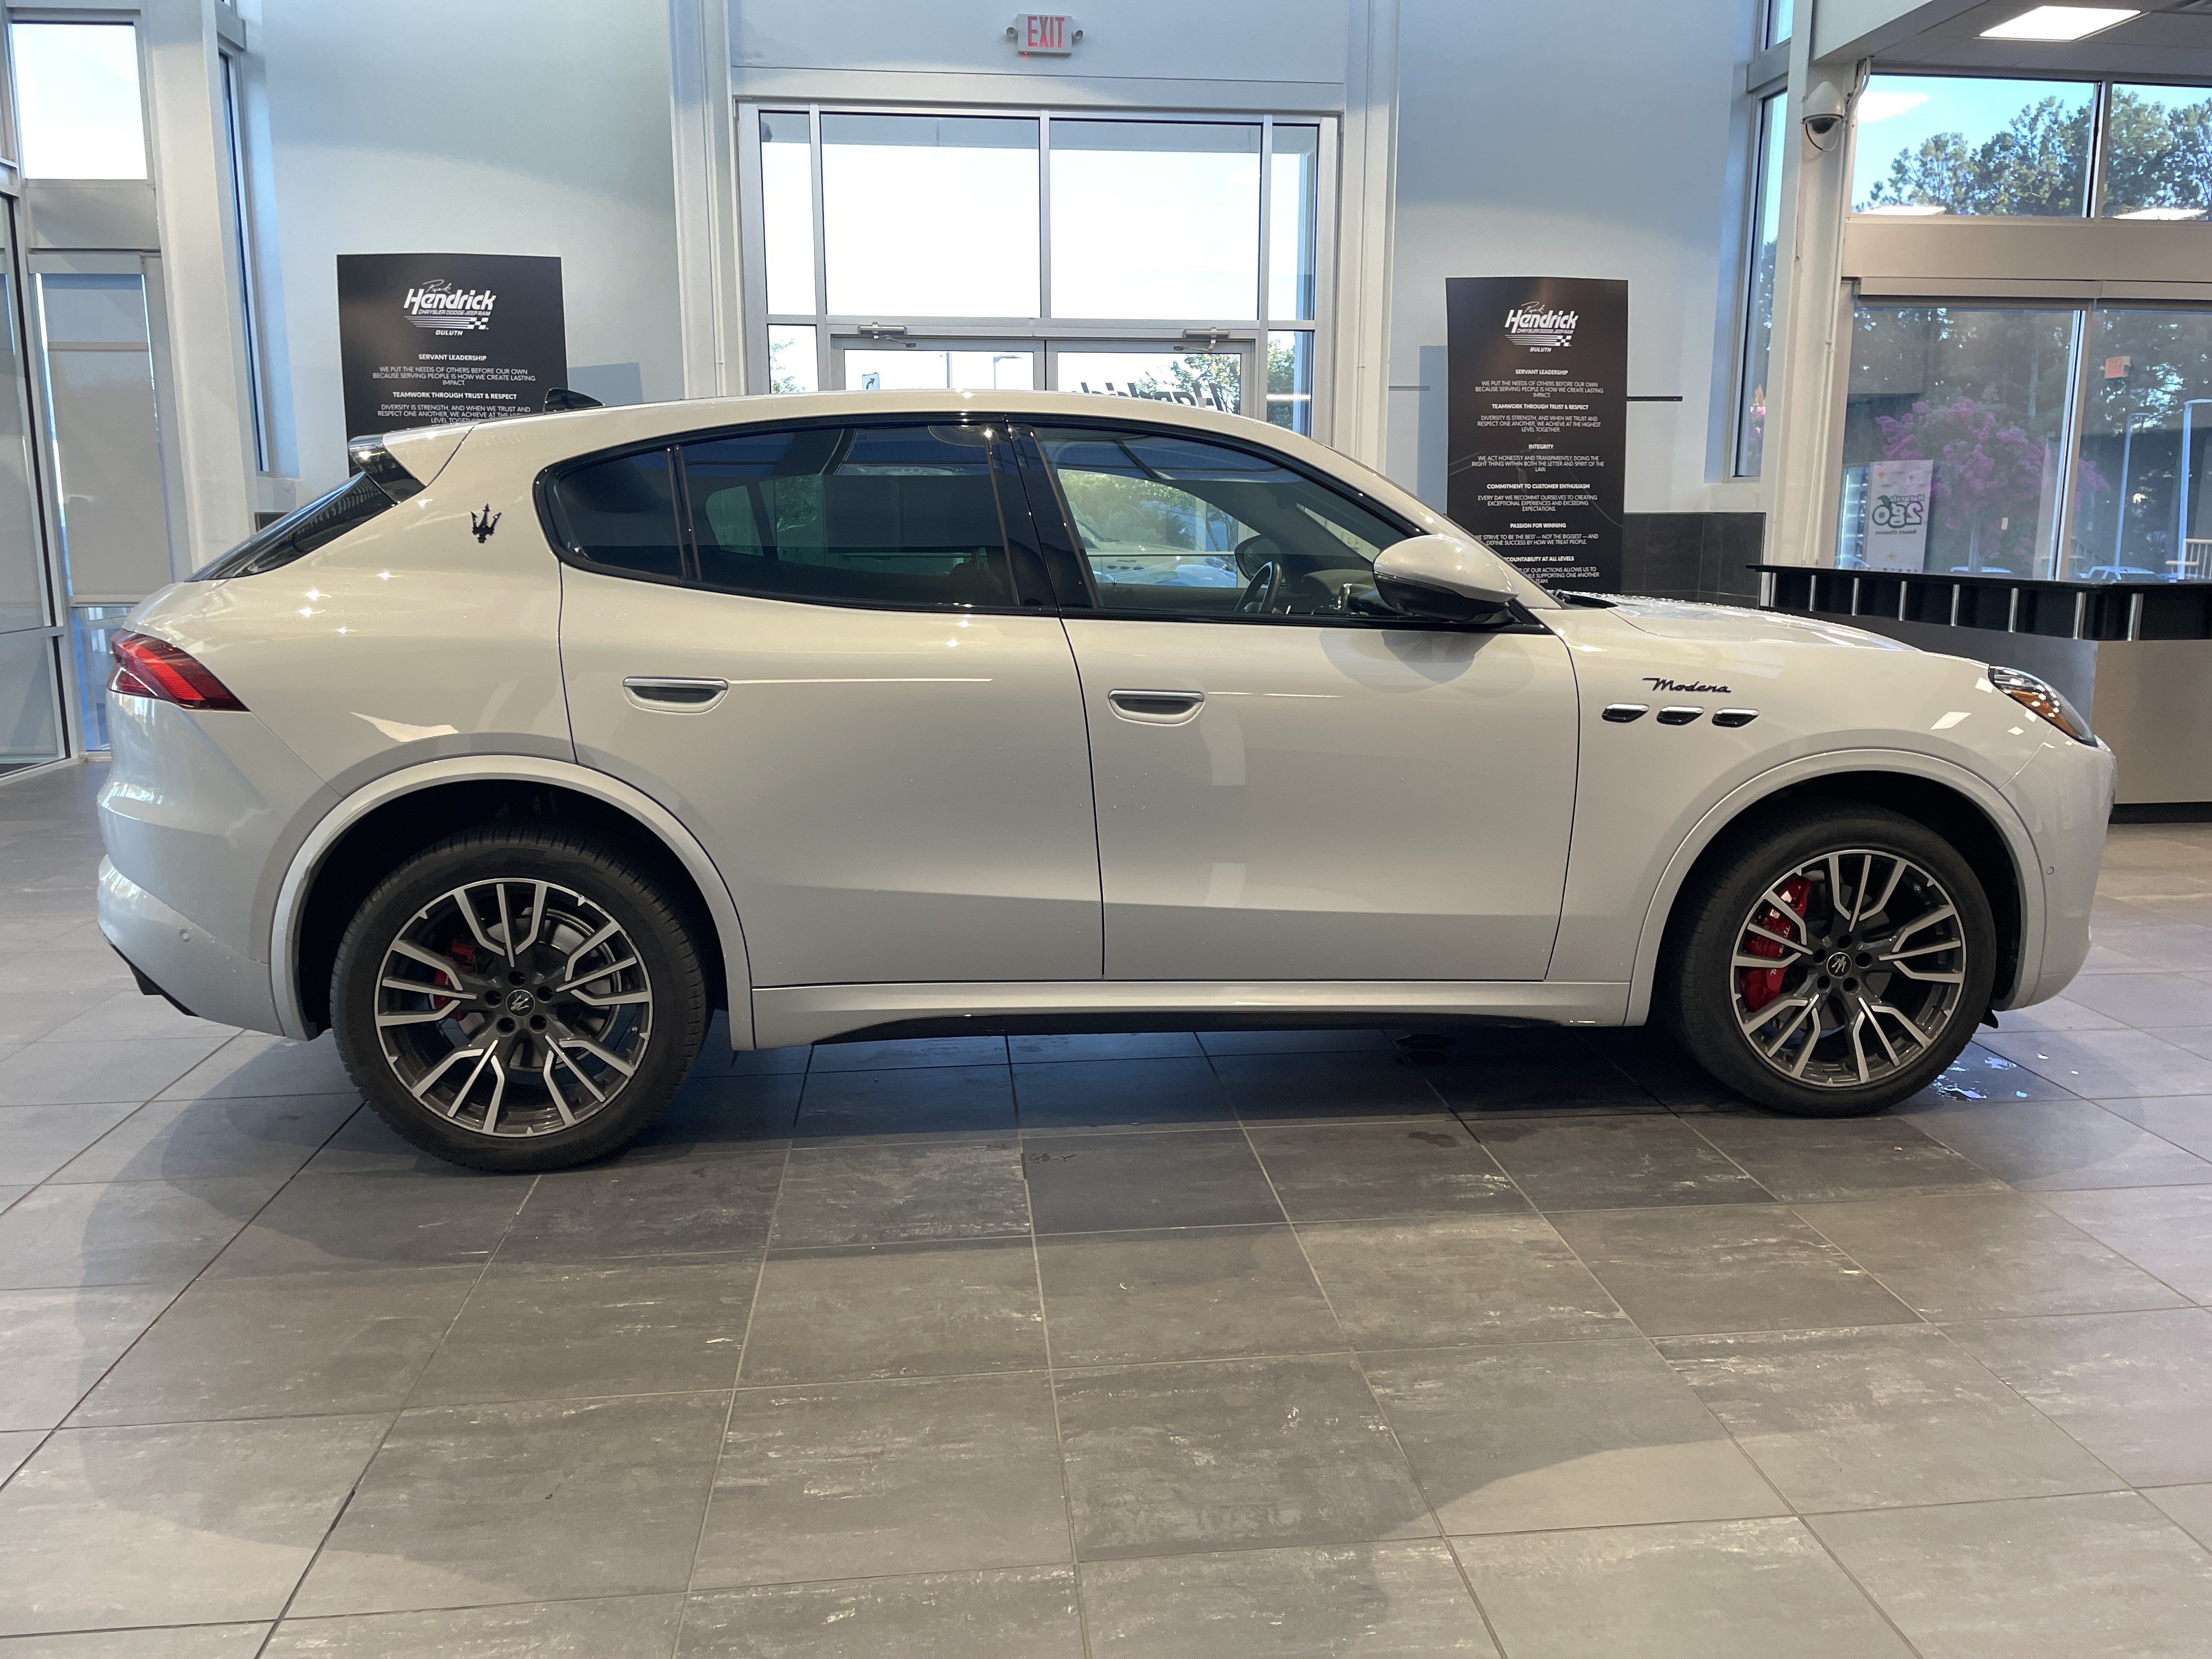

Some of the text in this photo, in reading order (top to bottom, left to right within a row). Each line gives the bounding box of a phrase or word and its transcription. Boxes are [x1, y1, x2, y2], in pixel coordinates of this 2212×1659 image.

[1028, 16, 1065, 48] EXIT
[403, 289, 496, 315] Hendrick
[1505, 309, 1578, 333] Hendrick
[1642, 677, 1732, 693] Modena
